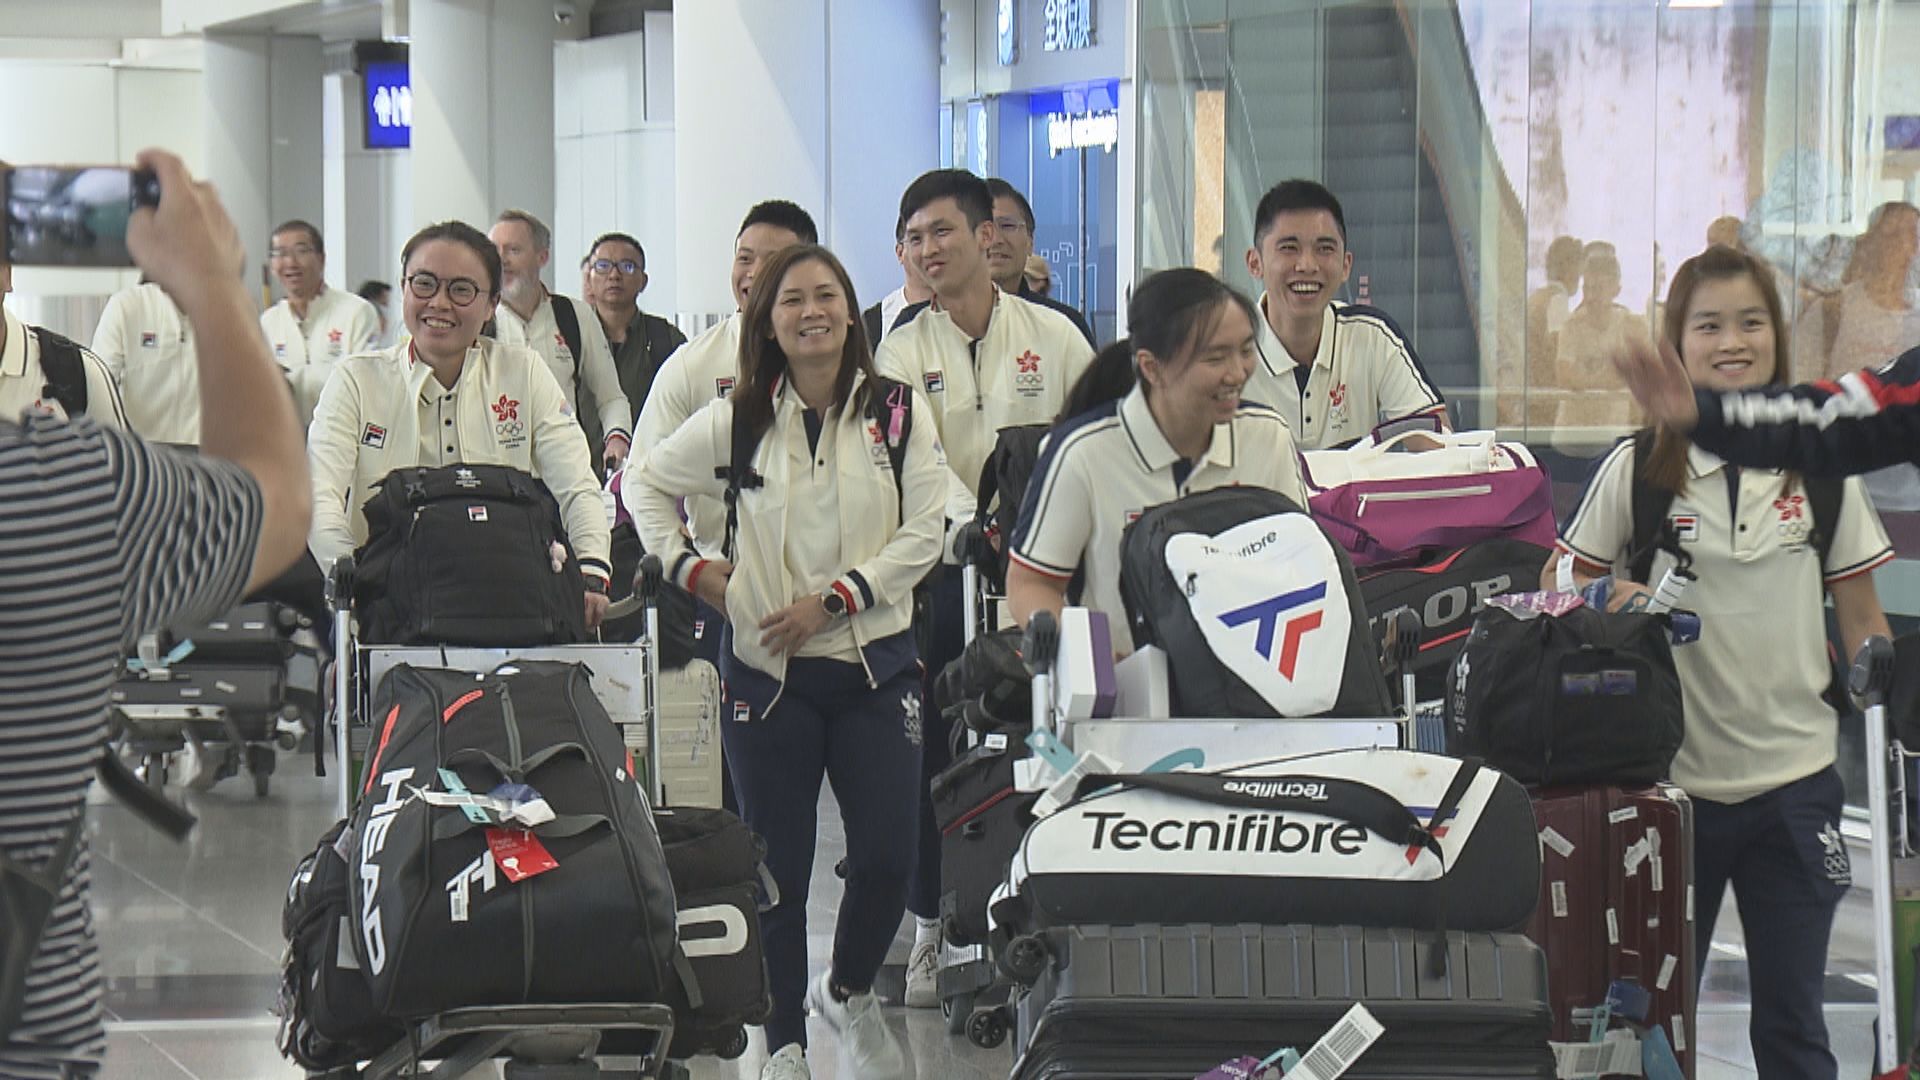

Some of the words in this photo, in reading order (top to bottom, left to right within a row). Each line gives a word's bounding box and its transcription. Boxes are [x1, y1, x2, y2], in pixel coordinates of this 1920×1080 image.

[1223, 780, 1329, 800] Tecnifibre
[1082, 811, 1368, 855] Tecnifibre
[361, 767, 415, 976] HEAD
